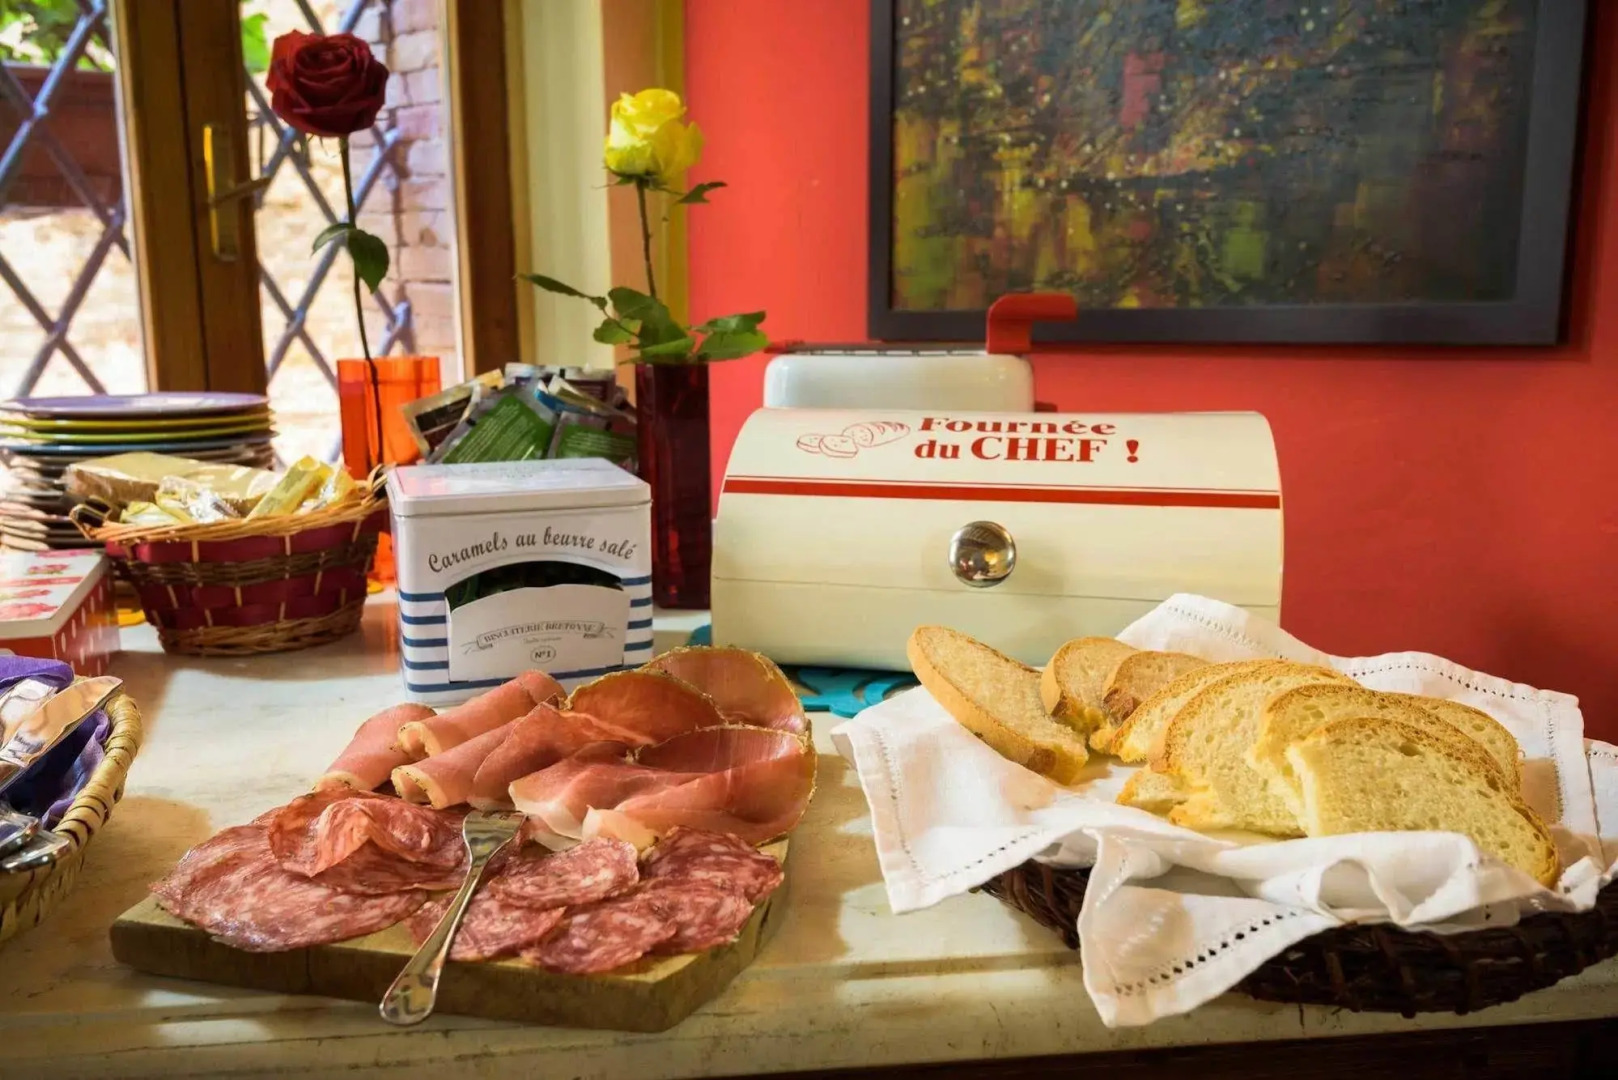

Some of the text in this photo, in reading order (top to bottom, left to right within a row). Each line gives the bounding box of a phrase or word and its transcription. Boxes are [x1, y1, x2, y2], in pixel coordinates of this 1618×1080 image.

[918, 416, 1117, 436] Fournée
[913, 439, 961, 460] du
[970, 435, 1108, 463] CHEF
[428, 526, 639, 573] Caramels au beurre salé
